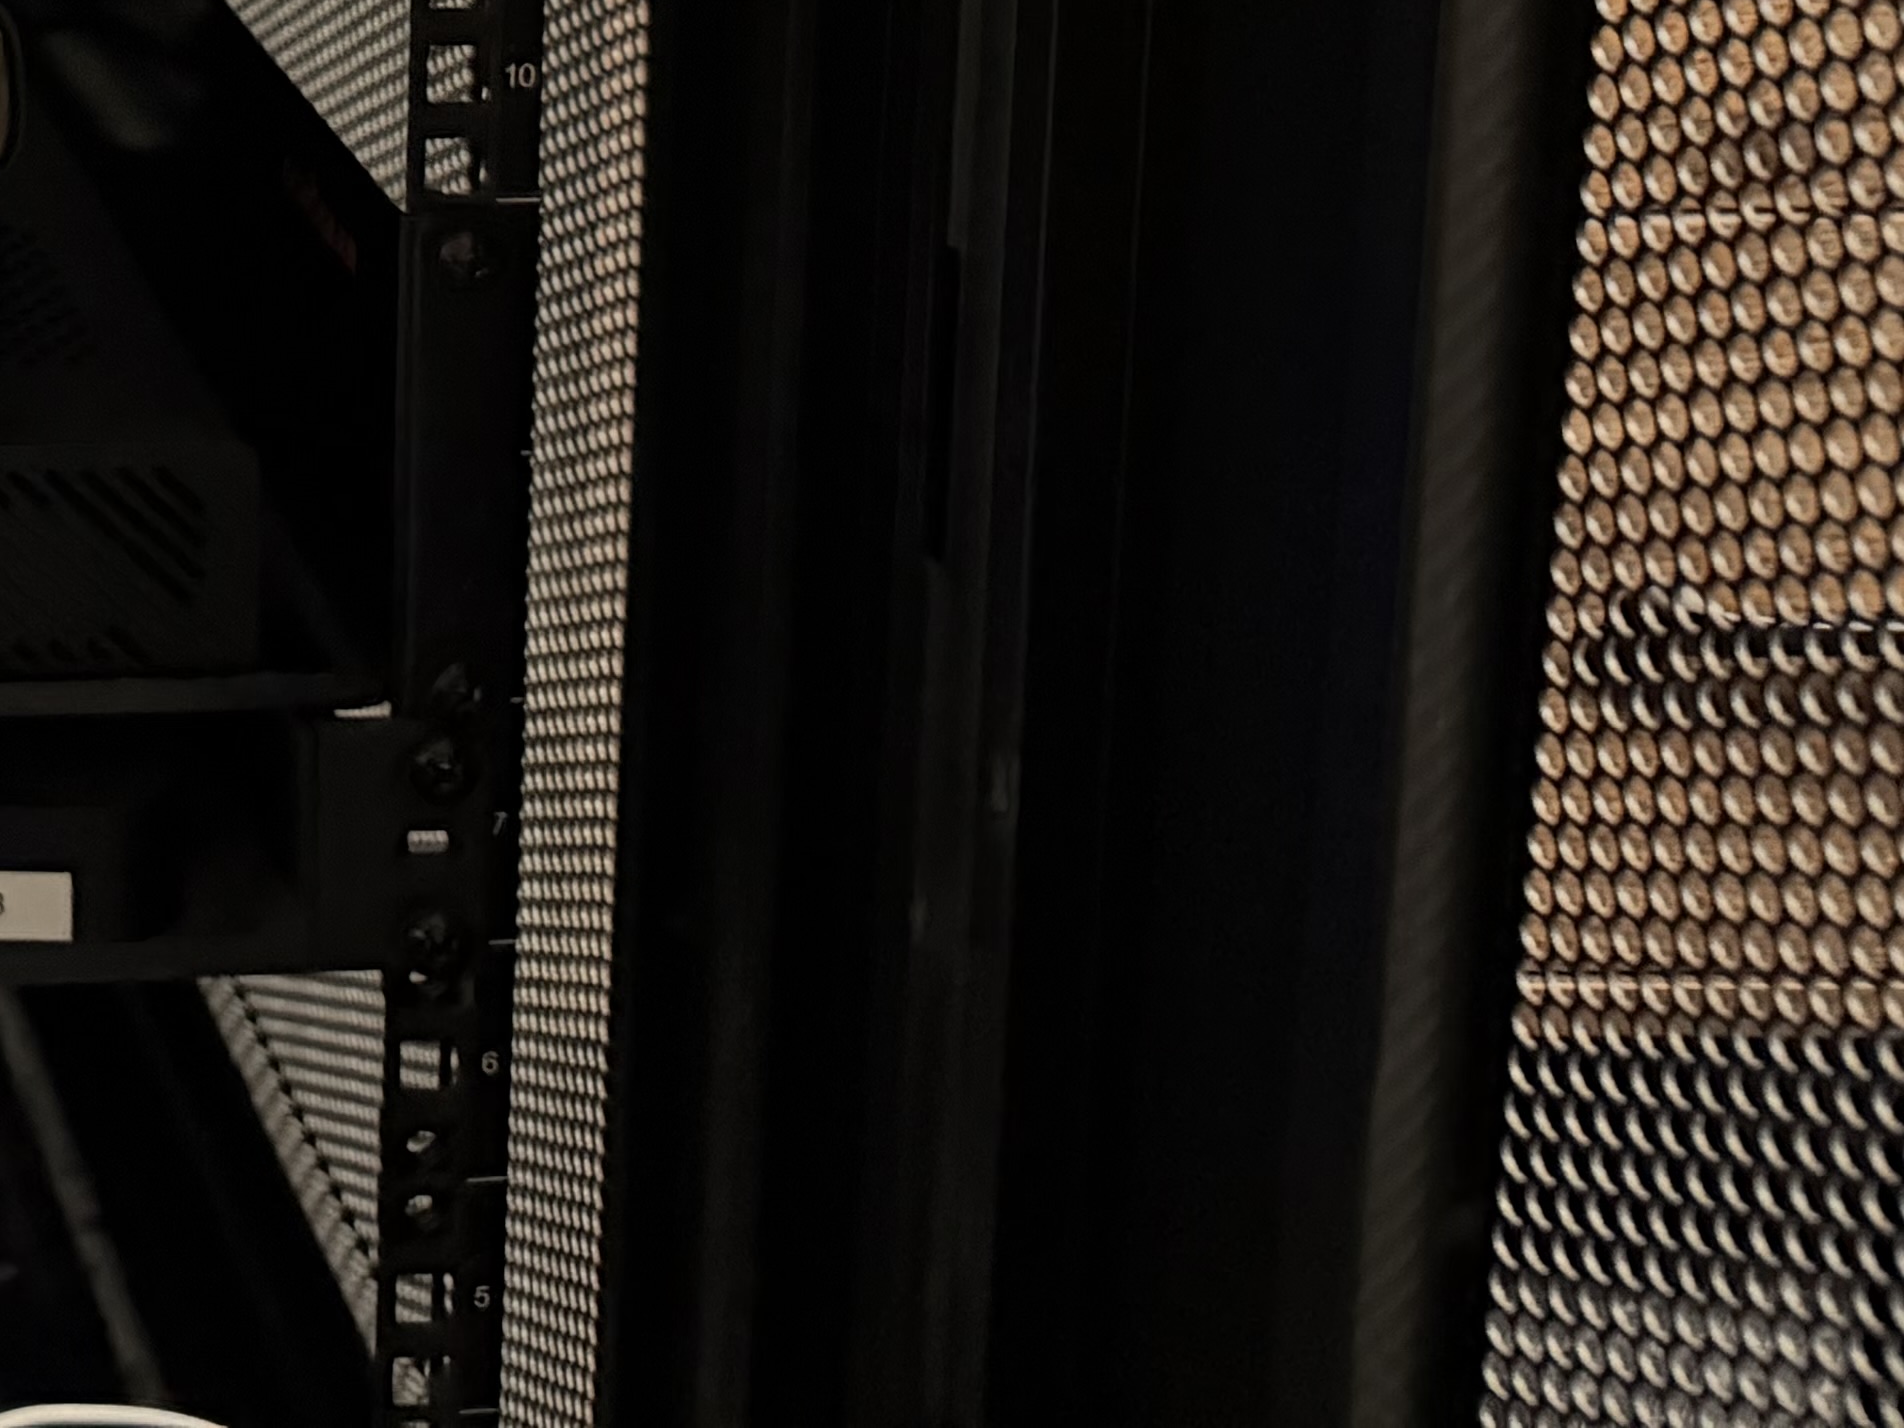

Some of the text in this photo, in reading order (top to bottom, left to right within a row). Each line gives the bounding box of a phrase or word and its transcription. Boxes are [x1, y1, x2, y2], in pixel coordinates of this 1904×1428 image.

[505, 62, 536, 89] 10
[481, 1050, 500, 1075] 6
[473, 1284, 491, 1308] 5
